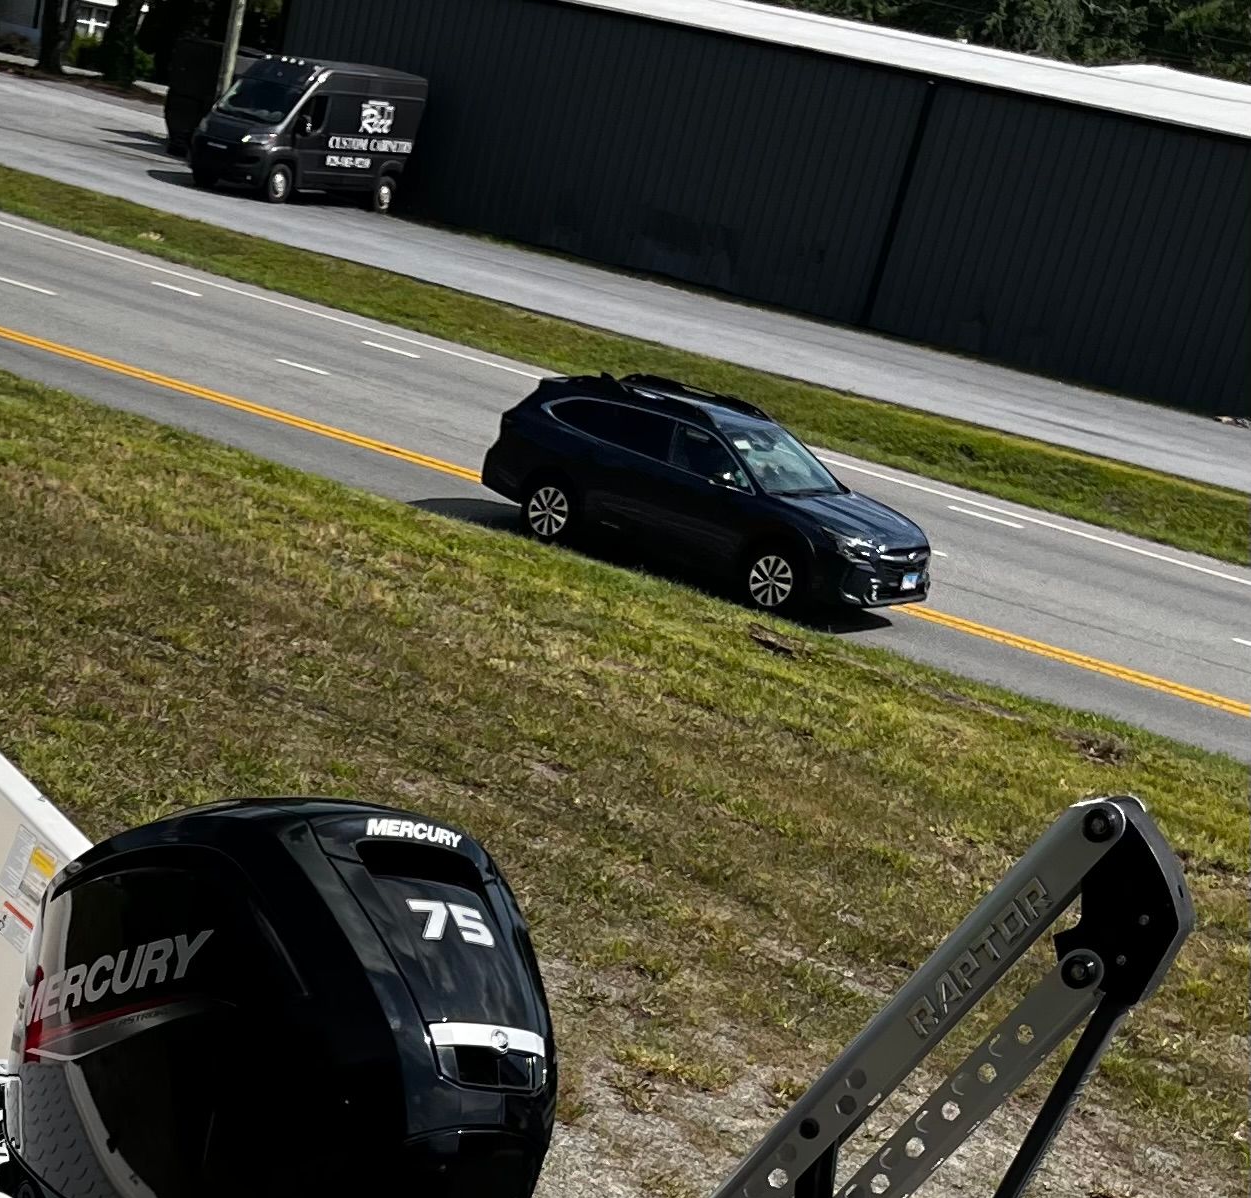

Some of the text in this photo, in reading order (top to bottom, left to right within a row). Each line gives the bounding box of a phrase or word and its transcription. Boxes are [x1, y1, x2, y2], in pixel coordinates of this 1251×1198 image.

[328, 136, 368, 151] CUSTOM
[366, 818, 462, 848] MERCURY
[405, 898, 496, 948] 75
[25, 929, 215, 1027] MERCURY
[905, 876, 1050, 1040] RAPTOR
